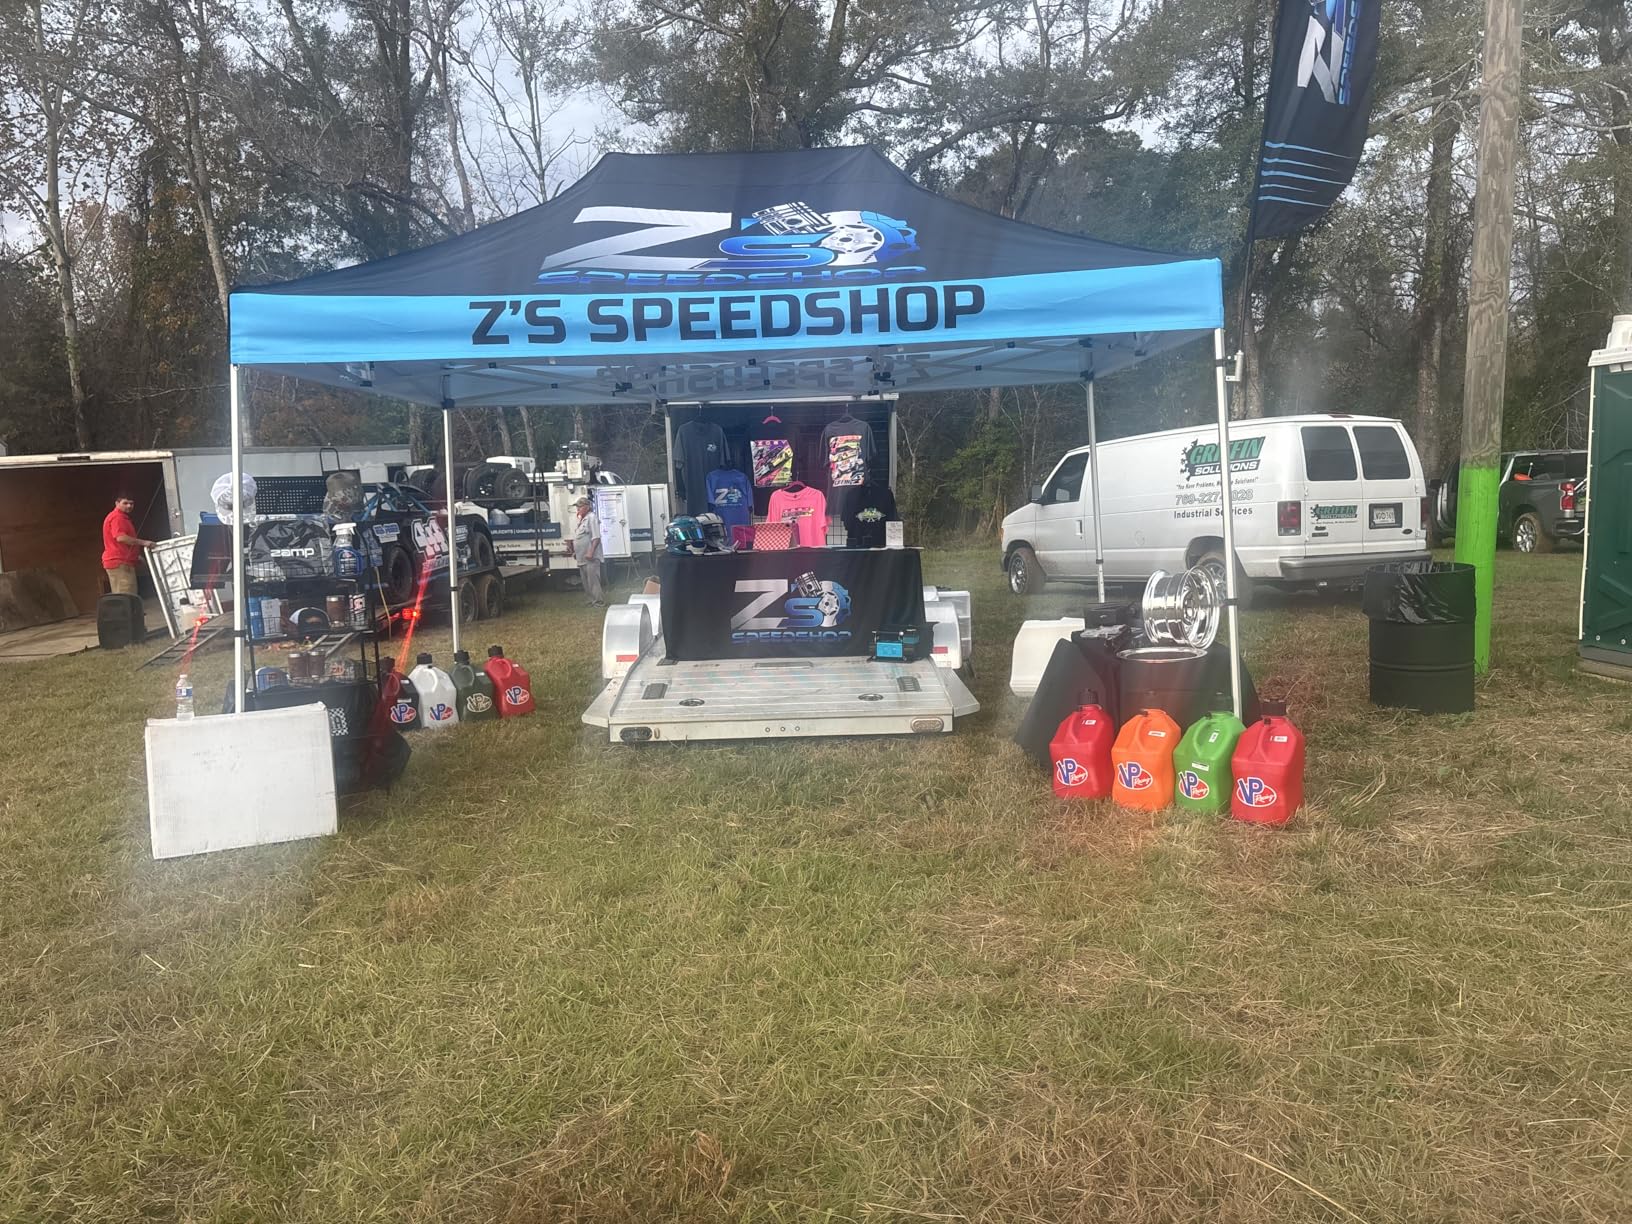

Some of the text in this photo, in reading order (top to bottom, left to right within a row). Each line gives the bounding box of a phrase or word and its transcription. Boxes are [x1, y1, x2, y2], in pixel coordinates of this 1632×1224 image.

[534, 265, 927, 287] SPEEDSHOP
[468, 284, 986, 346] Z'S SPEEDSHOP
[1190, 437, 1265, 465] GRIFIN
[1174, 508, 1212, 519] Industrial
[270, 548, 315, 558] zamp
[730, 631, 852, 644] SPEEDSHOP
[506, 686, 522, 705] VP
[391, 704, 409, 722] VP
[430, 704, 446, 721] VP
[1056, 758, 1077, 785] VP
[1117, 762, 1142, 788] VP
[1178, 771, 1199, 797] VP
[1237, 777, 1264, 805] VP
